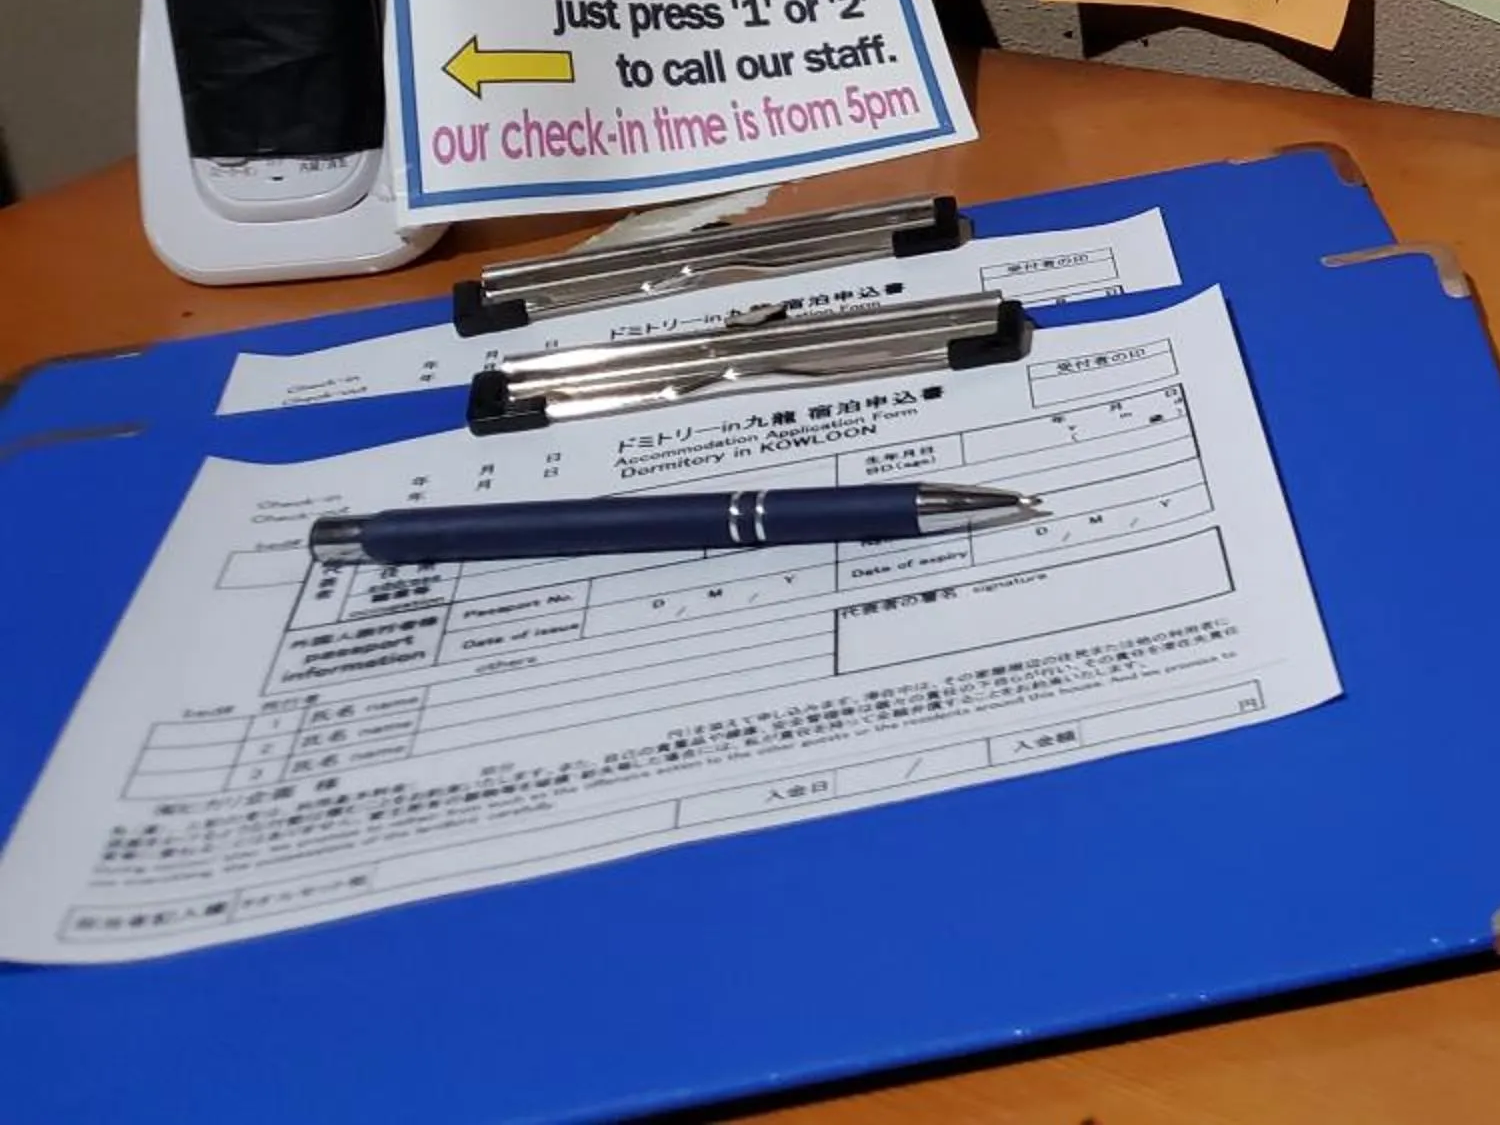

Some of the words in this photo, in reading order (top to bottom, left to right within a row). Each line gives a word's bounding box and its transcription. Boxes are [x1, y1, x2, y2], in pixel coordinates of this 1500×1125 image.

[616, 52, 654, 88] to
[663, 51, 727, 86] call
[736, 47, 795, 78] our
[803, 34, 898, 73] staff.
[432, 121, 490, 166] our
[501, 107, 649, 159] check-in
[652, 106, 728, 149] time
[731, 99, 759, 141] is
[763, 94, 843, 136] from
[846, 85, 921, 130] 5pm
[614, 432, 759, 468] Accommodation
[766, 416, 866, 441] Application
[872, 407, 919, 423] Form
[620, 452, 726, 479] Dormitory
[733, 445, 752, 459] in
[760, 423, 878, 454] KOWLOON
[851, 565, 892, 579] Date
